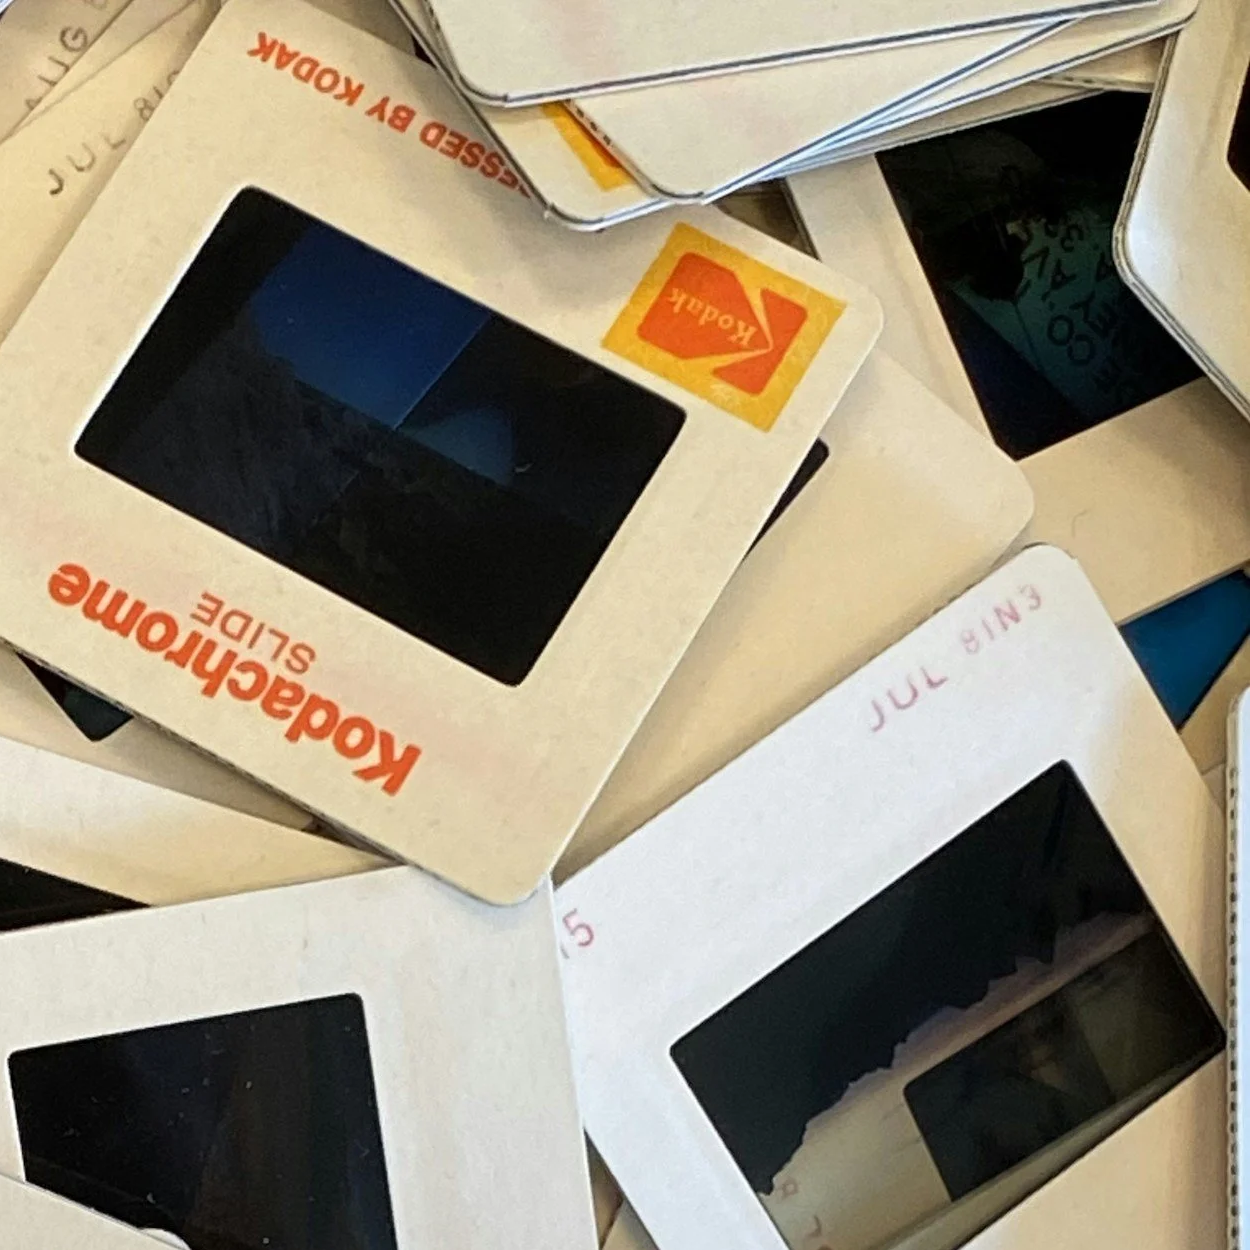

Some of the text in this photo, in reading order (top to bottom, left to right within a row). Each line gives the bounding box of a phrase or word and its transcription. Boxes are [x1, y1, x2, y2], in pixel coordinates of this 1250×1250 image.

[247, 31, 365, 107] KODAK
[365, 96, 417, 133] BY
[48, 132, 127, 196] JUL
[668, 287, 758, 347] Kodak
[190, 591, 317, 675] SLIDE
[47, 562, 422, 797] Kodachrome
[871, 666, 950, 733] JUL
